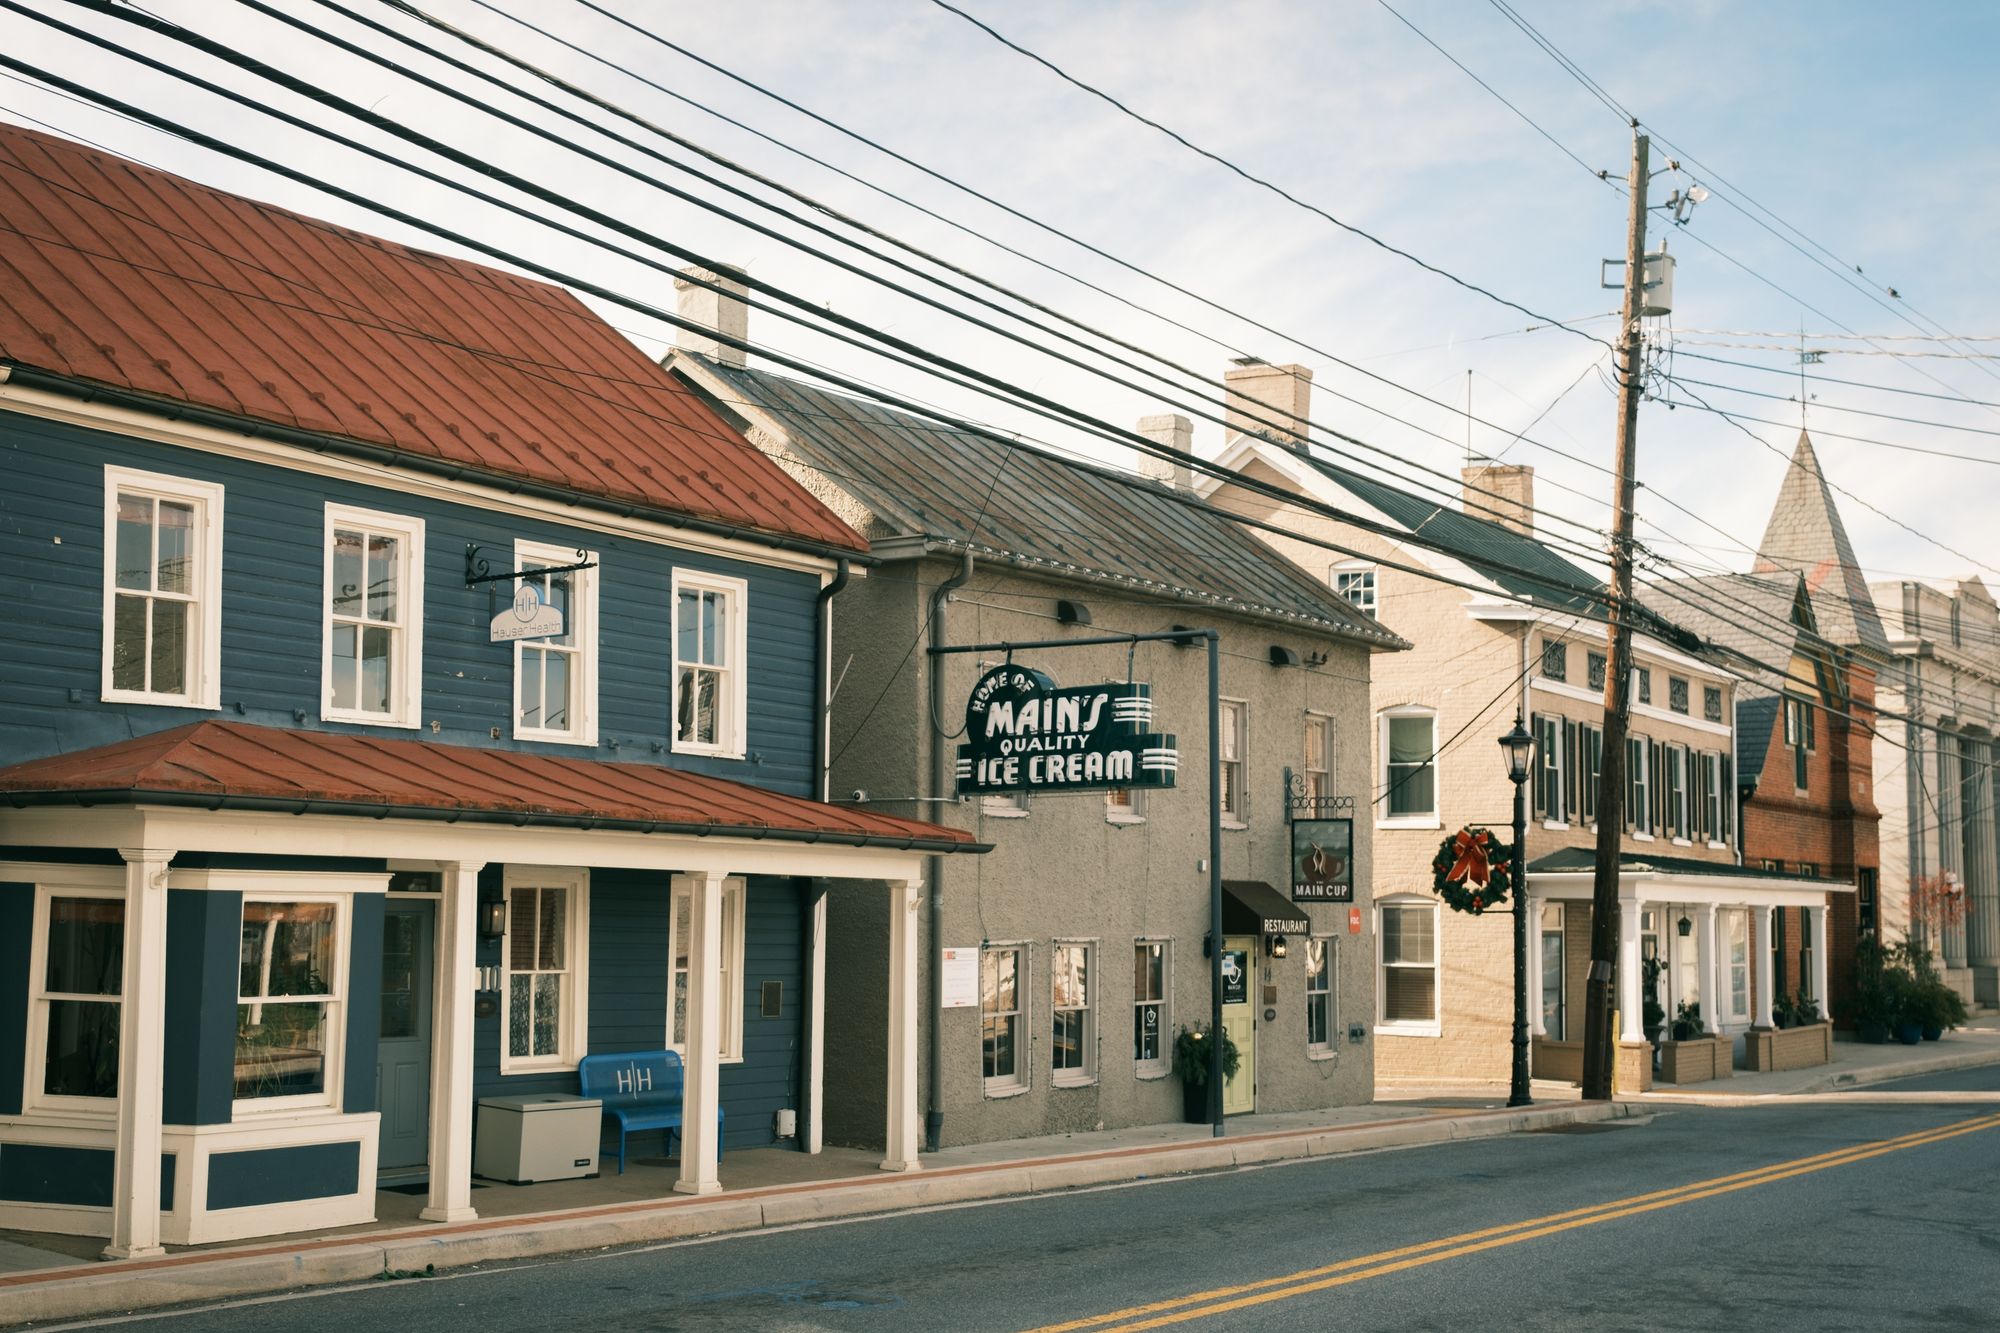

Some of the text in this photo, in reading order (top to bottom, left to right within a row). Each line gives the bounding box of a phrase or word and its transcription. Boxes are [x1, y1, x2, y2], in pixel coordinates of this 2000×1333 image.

[970, 671, 1008, 713] HOME
[985, 693, 1109, 738] MAIN'S
[1000, 734, 1090, 756] QUALITY
[977, 750, 1134, 785] ICE CREAM
[1295, 884, 1348, 896] MAIN CUP
[1264, 919, 1308, 933] RESTAURANT
[480, 965, 501, 992] 10
